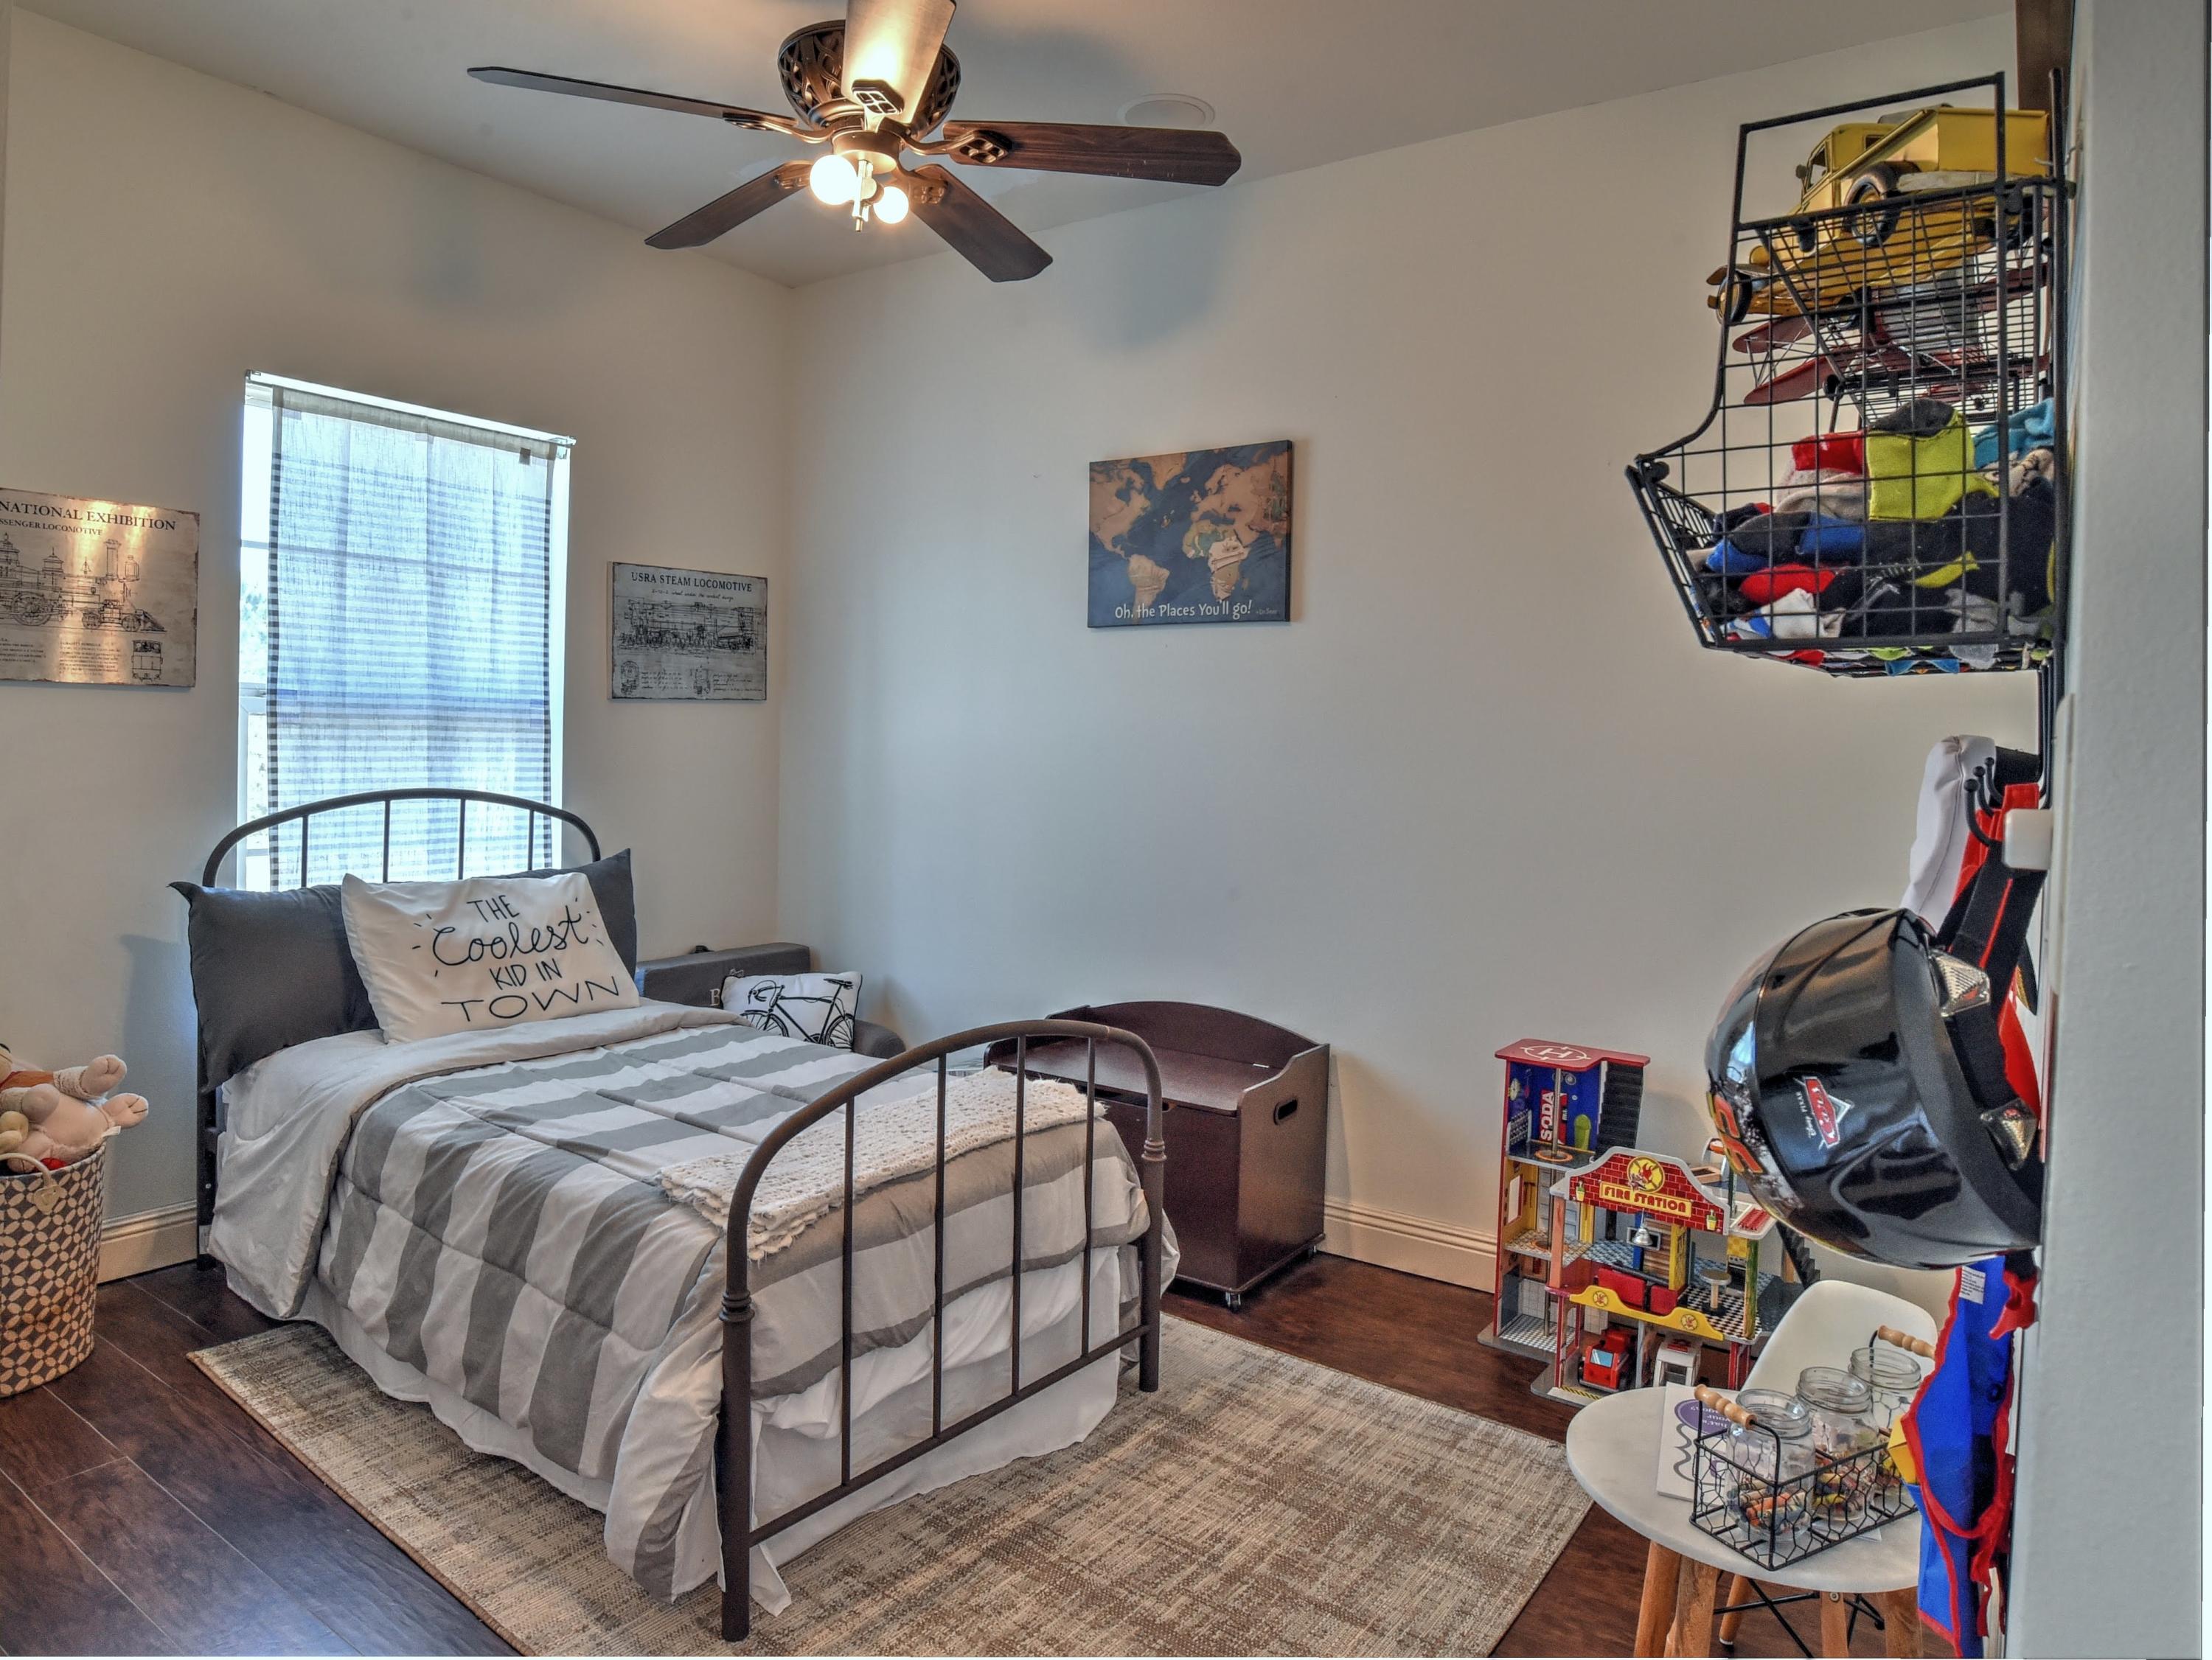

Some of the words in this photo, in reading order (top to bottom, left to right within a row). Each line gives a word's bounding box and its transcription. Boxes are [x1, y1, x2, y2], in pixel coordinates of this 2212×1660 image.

[0, 501, 83, 520] NATIONAL
[87, 511, 176, 531] EXHIBITION
[43, 522, 103, 536] LOCOMOTIVE
[631, 572, 656, 584] USRA
[659, 575, 691, 587] STEAM
[694, 578, 753, 593] LOCOMOTIVE
[1137, 603, 1155, 618] the
[1158, 604, 1195, 618] Places
[1198, 600, 1229, 615] You'll
[1233, 600, 1253, 620] go!
[467, 895, 521, 923] THE
[432, 905, 589, 966] Coolest
[489, 963, 527, 990] KID
[536, 958, 563, 981] IN
[440, 976, 620, 1022] TOWN
[1795, 1091, 1808, 1113] PIXAR
[1540, 1092, 1554, 1141] SODA
[1604, 1186, 1631, 1200] FIRE
[1634, 1193, 1686, 1213] STATION
